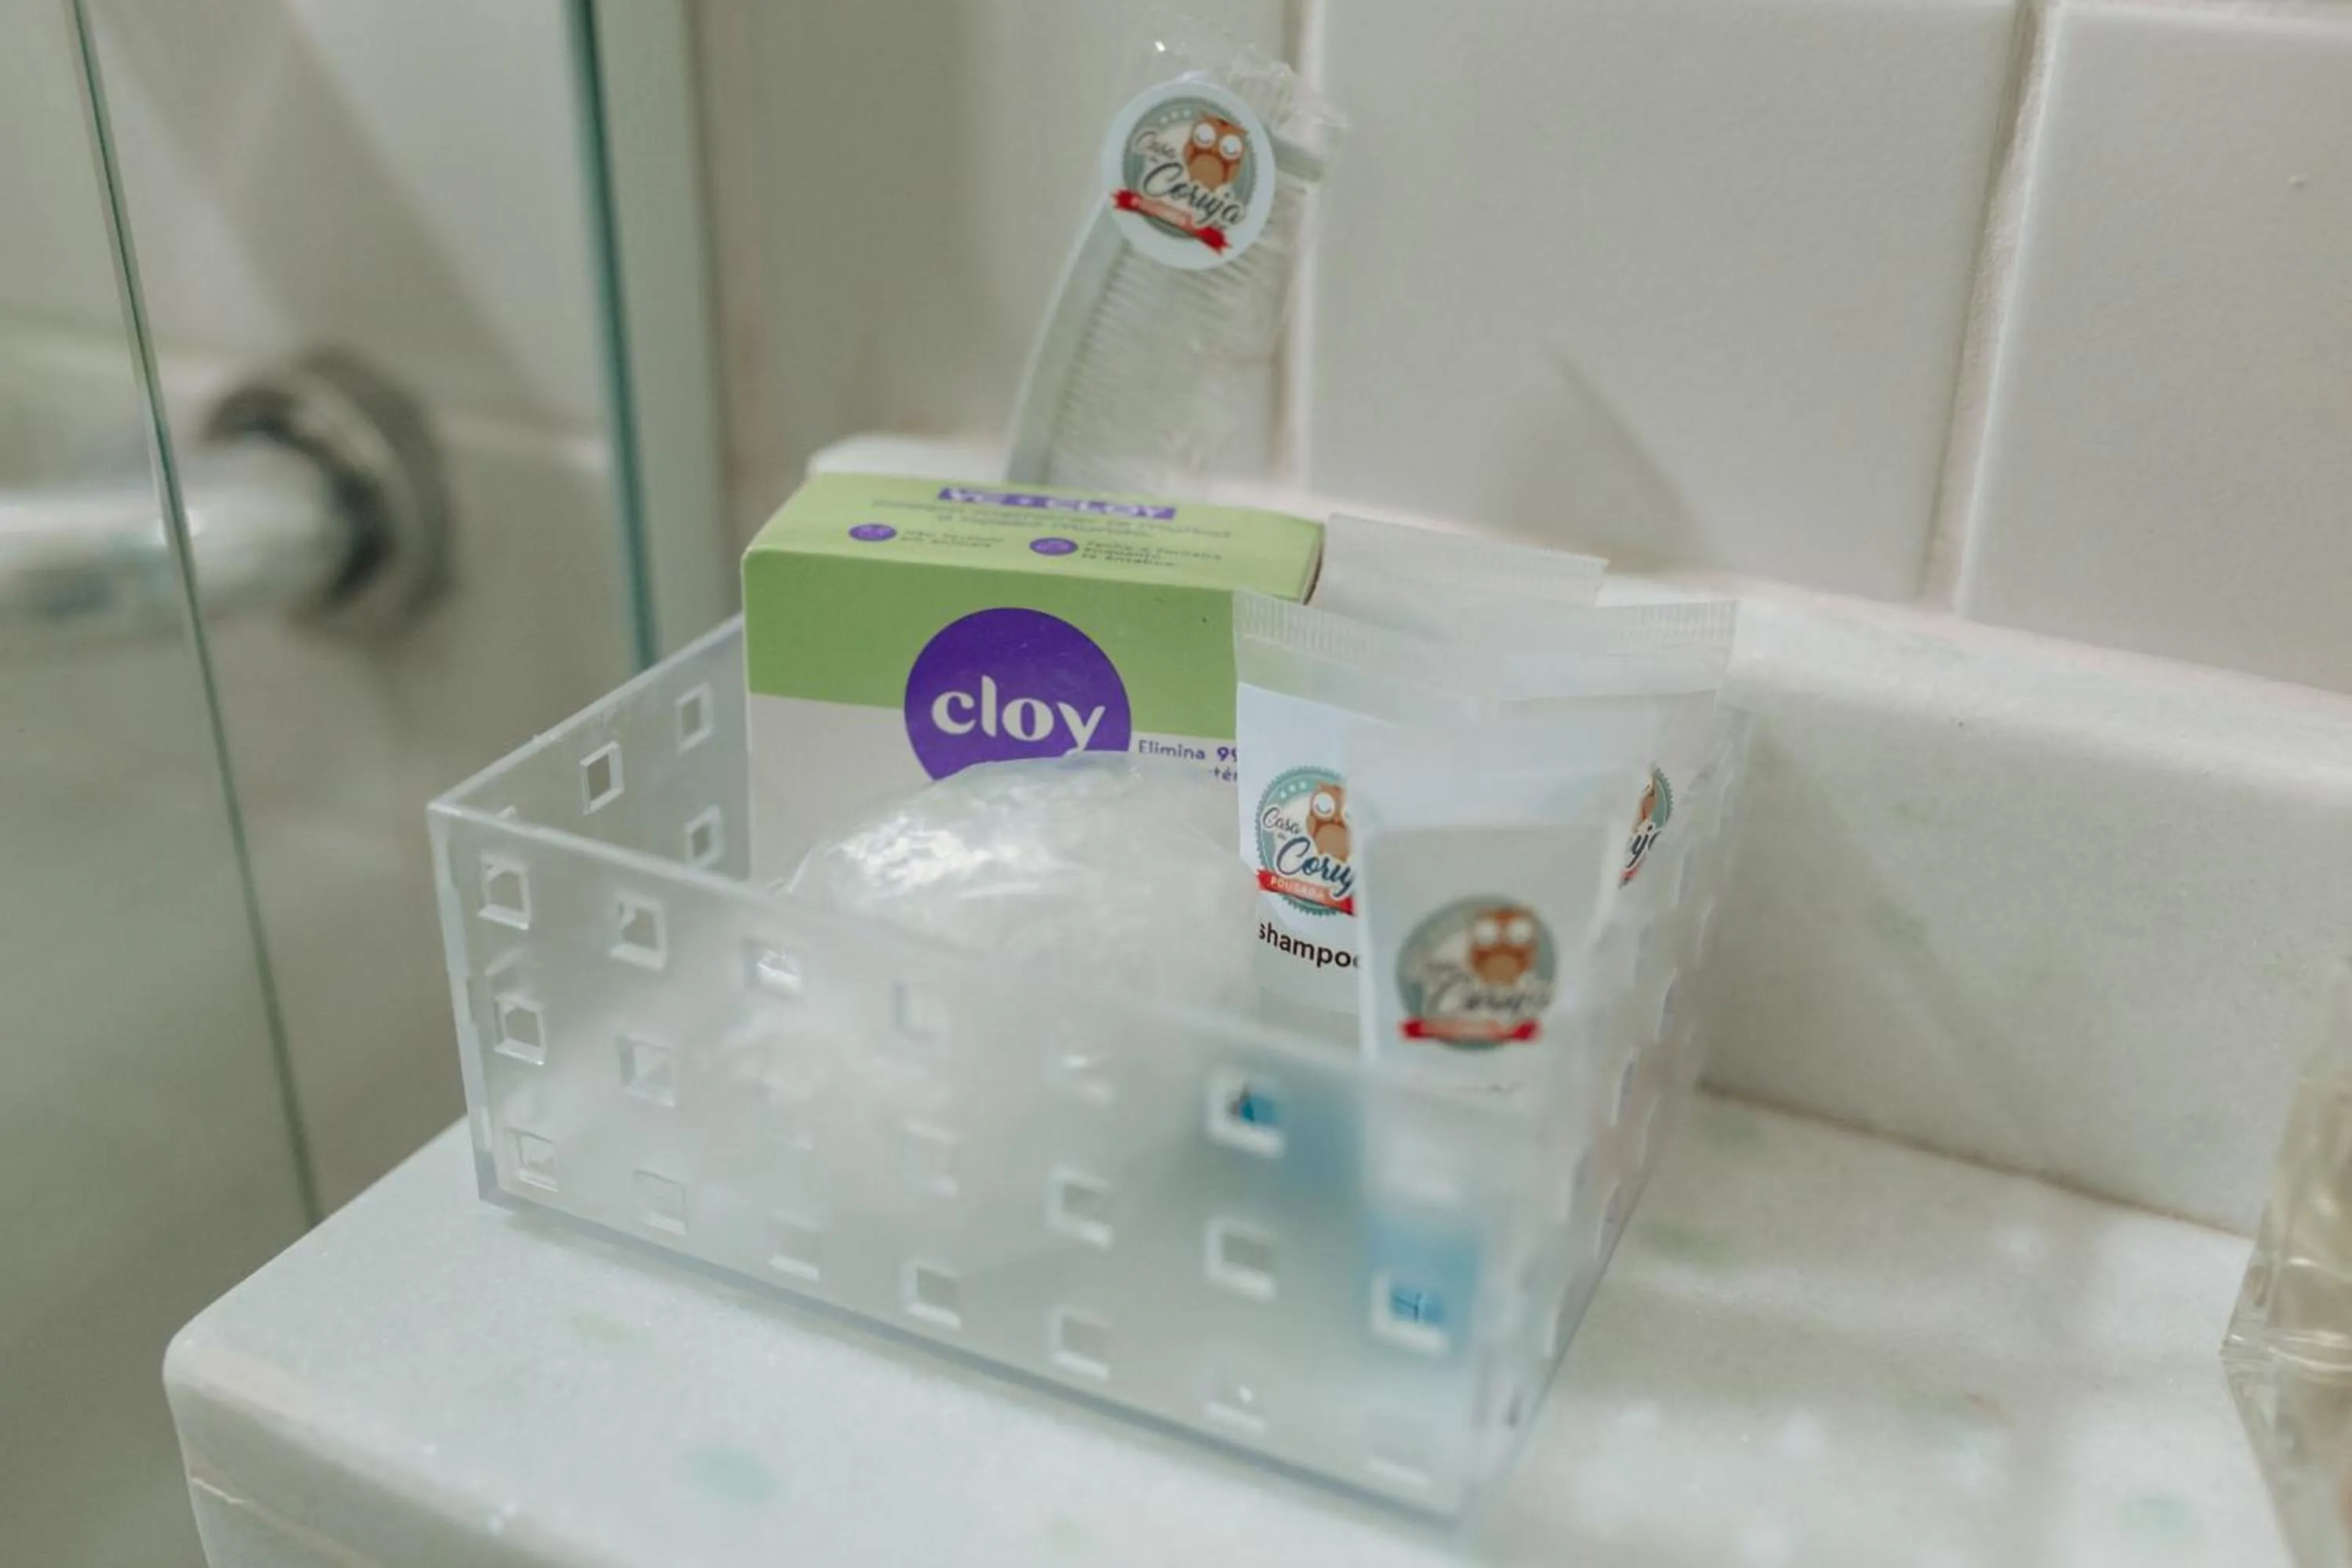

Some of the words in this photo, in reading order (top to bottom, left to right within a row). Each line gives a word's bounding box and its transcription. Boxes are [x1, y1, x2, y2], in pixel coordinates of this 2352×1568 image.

[1143, 162, 1241, 225] Coruja
[931, 675, 1106, 751] cloy
[1138, 739, 1206, 760] Elimina
[1262, 806, 1301, 834] Casa
[1276, 836, 1352, 898] Coruj
